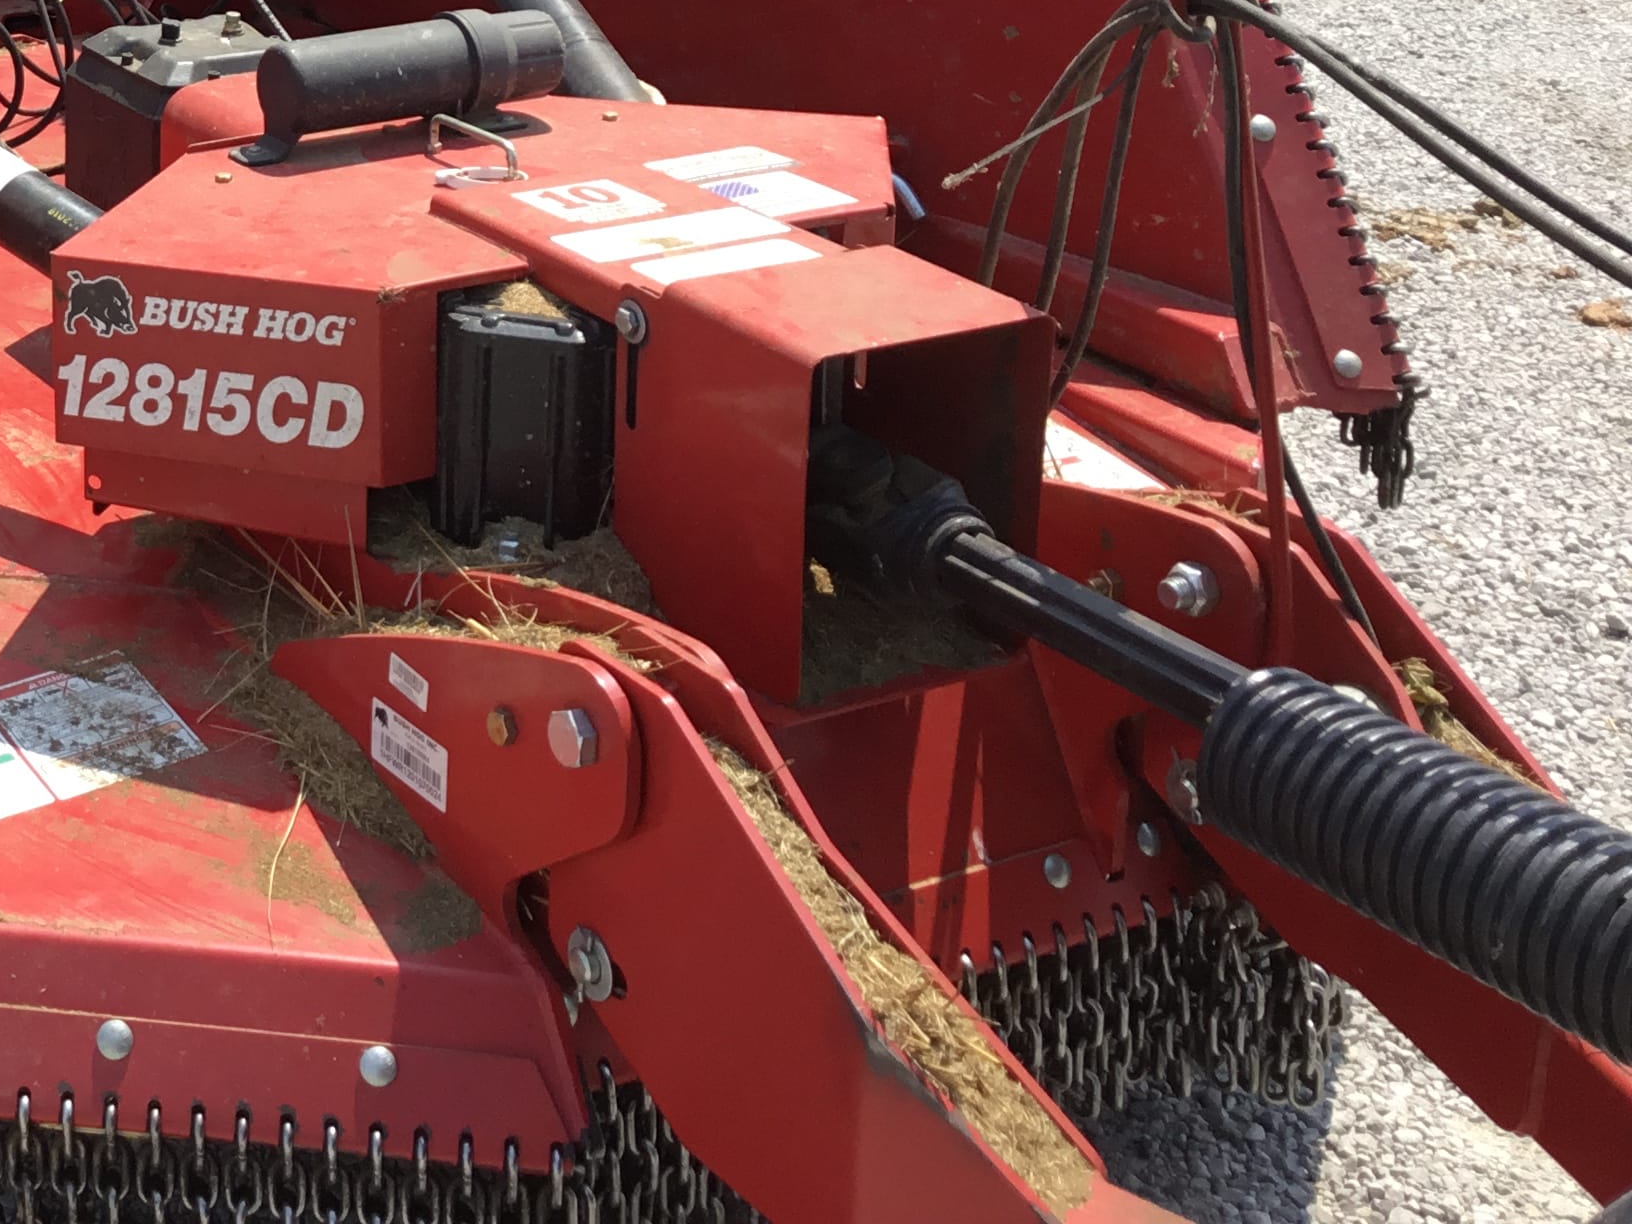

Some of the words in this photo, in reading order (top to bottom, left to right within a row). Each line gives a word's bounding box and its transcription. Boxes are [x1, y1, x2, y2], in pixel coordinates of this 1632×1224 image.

[537, 186, 621, 210] 10
[139, 295, 250, 337] BUSH
[252, 307, 348, 347] HOG
[57, 353, 365, 450] 12815CD
